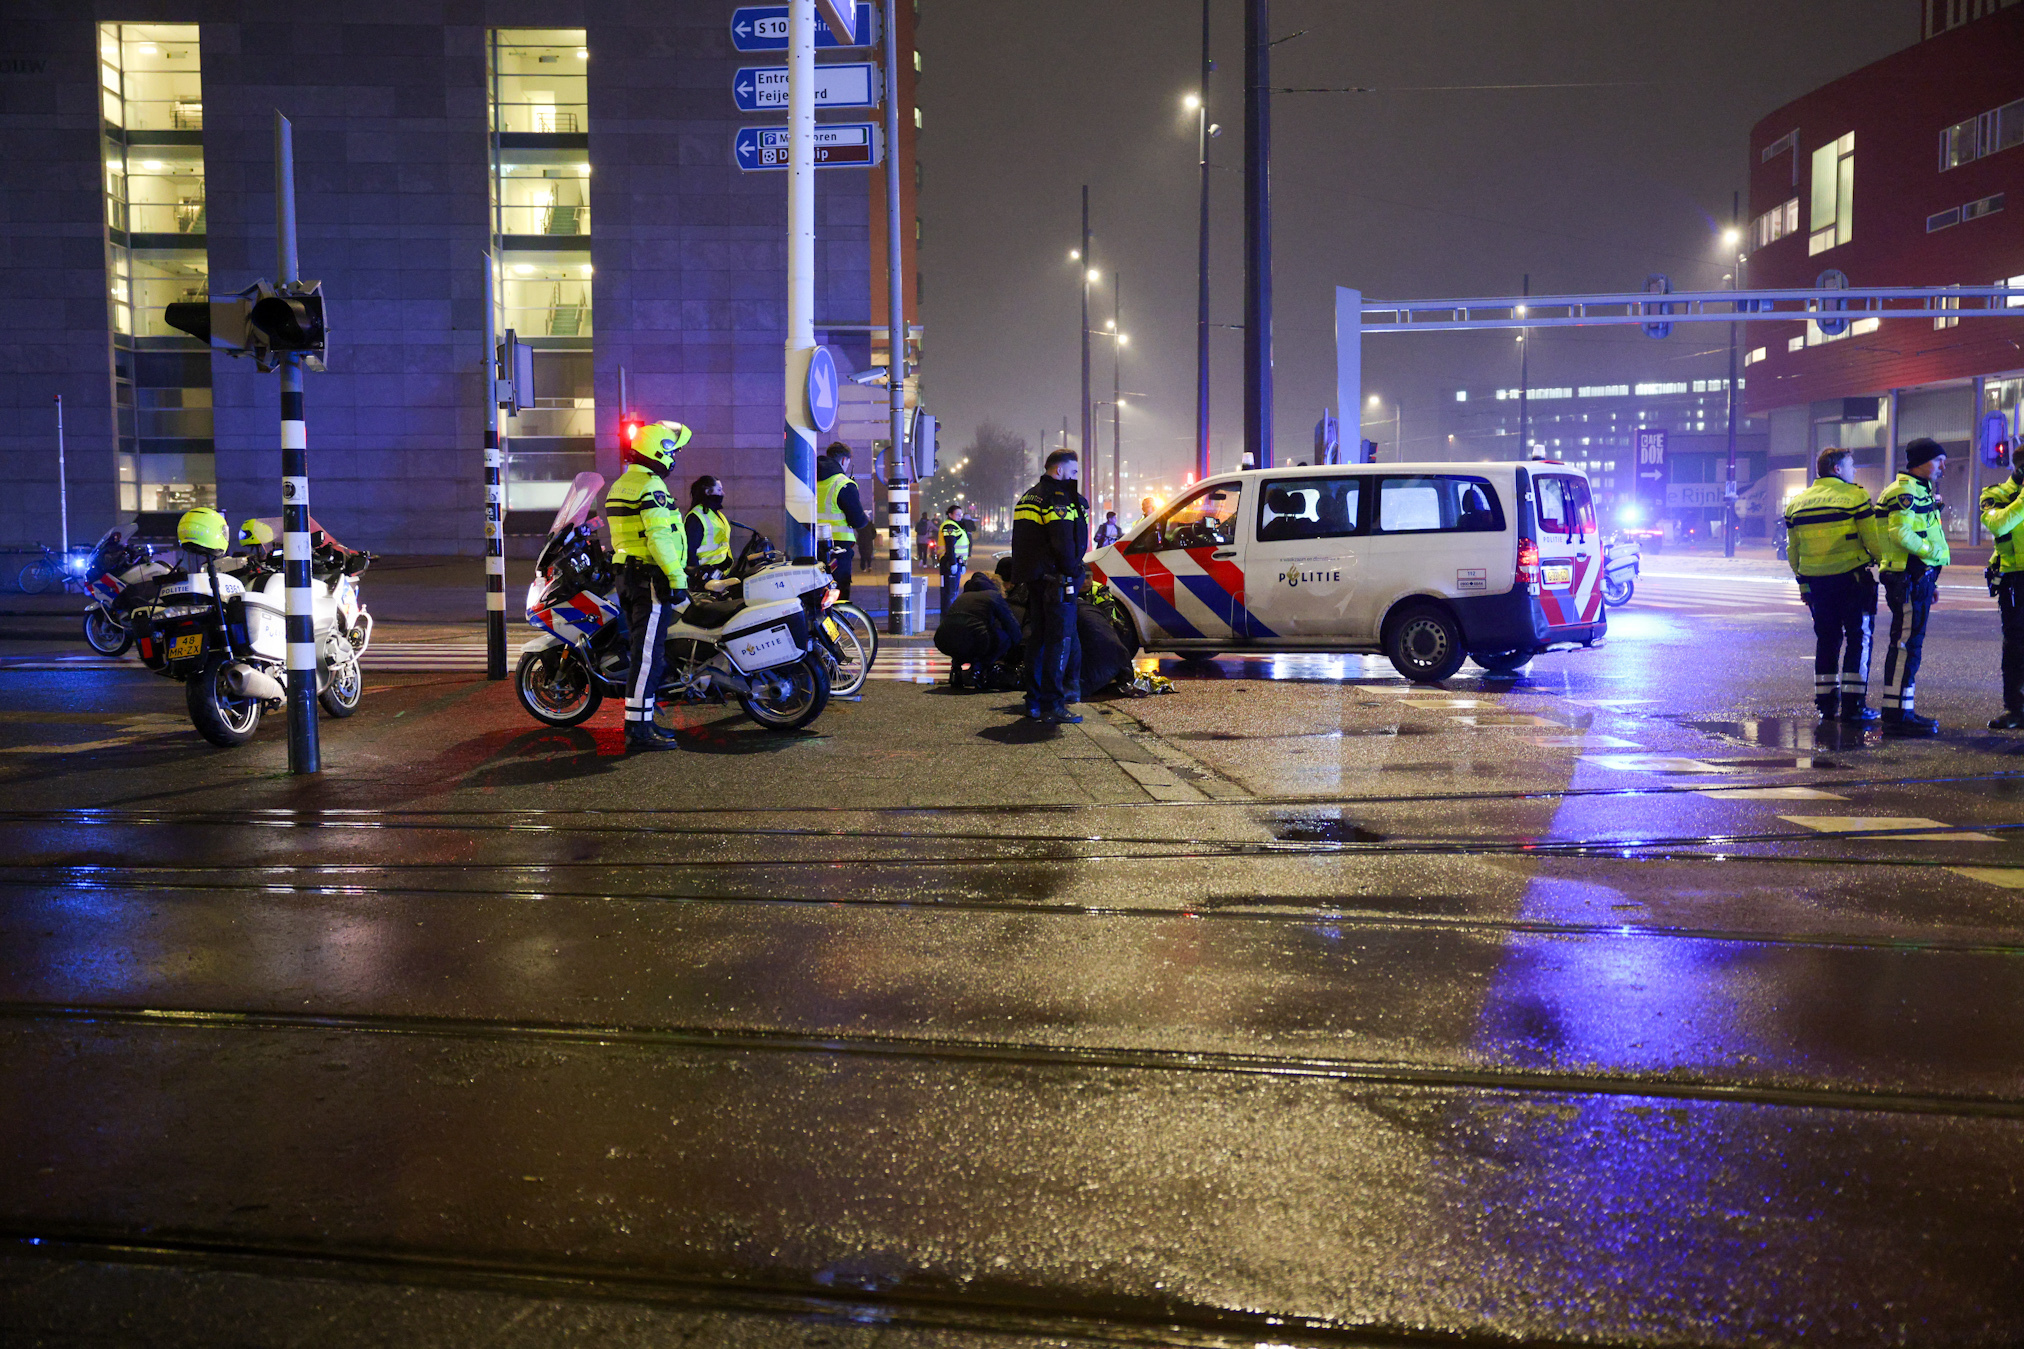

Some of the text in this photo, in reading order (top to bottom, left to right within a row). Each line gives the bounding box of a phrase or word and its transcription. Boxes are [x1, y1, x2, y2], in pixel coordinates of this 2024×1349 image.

[759, 22, 766, 34] S
[770, 21, 788, 33] 10
[758, 73, 789, 84] Entre
[758, 88, 828, 104] Feijerd
[1641, 445, 1664, 465] DOX
[1682, 487, 1726, 506] Rijnh
[774, 581, 785, 590] 14
[1279, 571, 1340, 587] POLITIE
[161, 585, 190, 595] POLITIE
[182, 636, 195, 645] 48
[741, 637, 782, 656] POLITIE
[169, 644, 199, 656] MR-ZX
